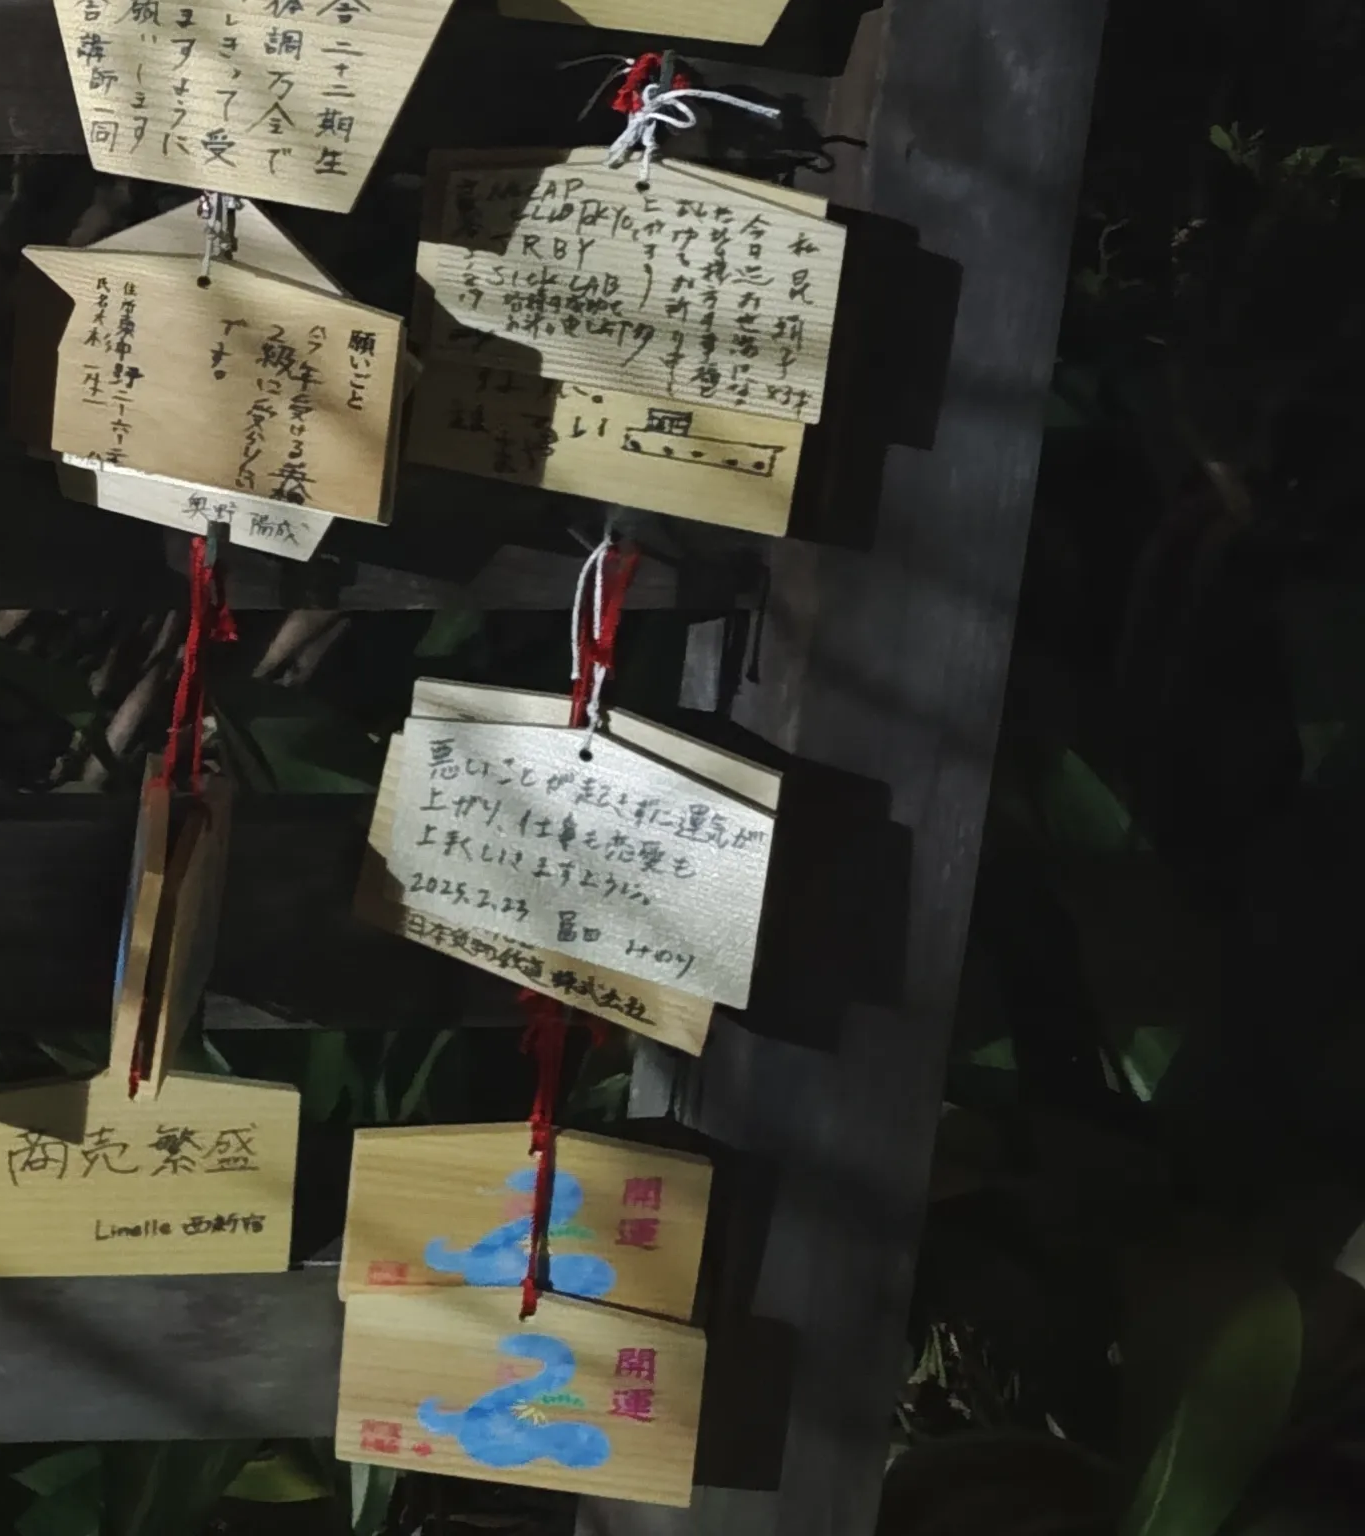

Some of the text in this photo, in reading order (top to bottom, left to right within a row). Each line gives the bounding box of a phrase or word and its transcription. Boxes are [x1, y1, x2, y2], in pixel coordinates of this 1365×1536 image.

[346, 328, 378, 411] 願いごと
[7, 1121, 262, 1188] 商売繁盛
[609, 1347, 657, 1423] 開運
